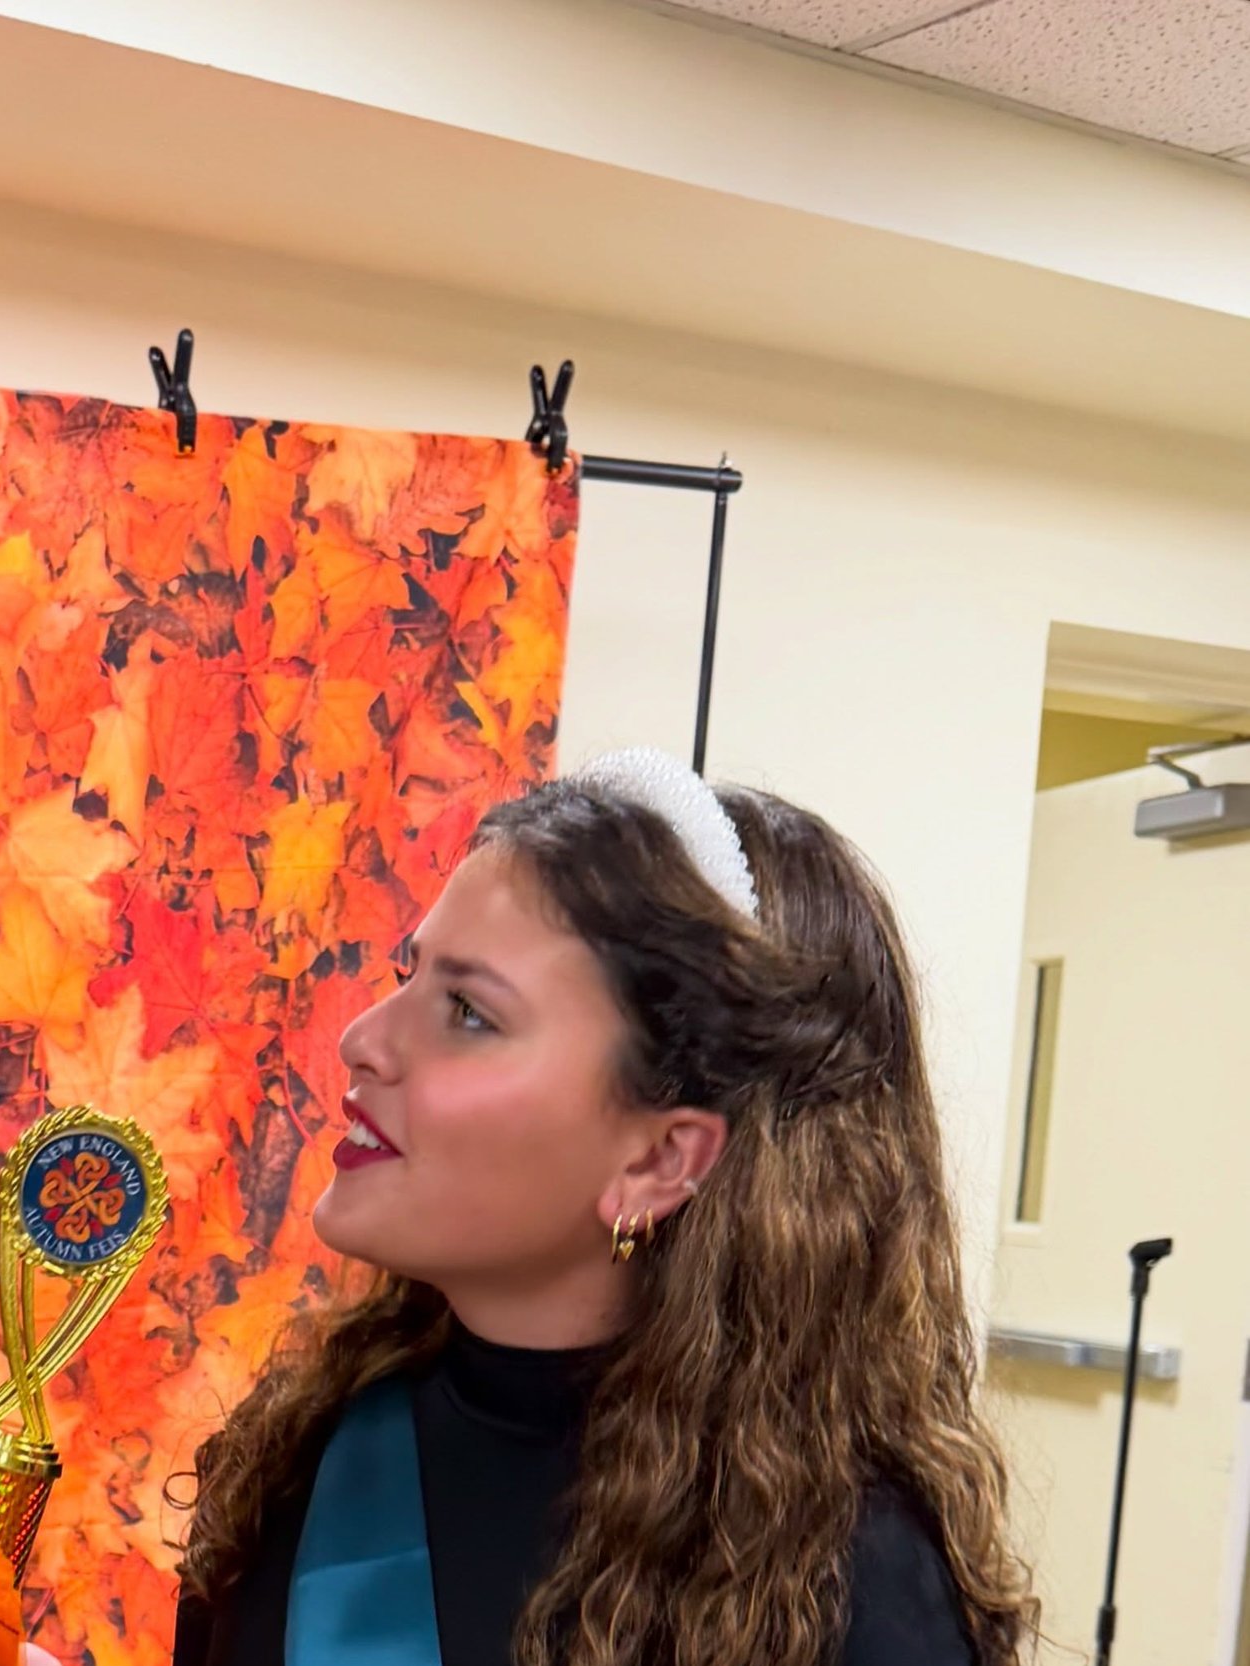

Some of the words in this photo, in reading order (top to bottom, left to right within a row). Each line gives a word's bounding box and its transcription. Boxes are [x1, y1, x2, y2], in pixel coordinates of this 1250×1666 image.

[37, 1139, 73, 1168] NEW
[79, 1136, 141, 1195] ENGLAND
[25, 1207, 82, 1259] AUTUMN
[88, 1229, 124, 1258] FEIS
